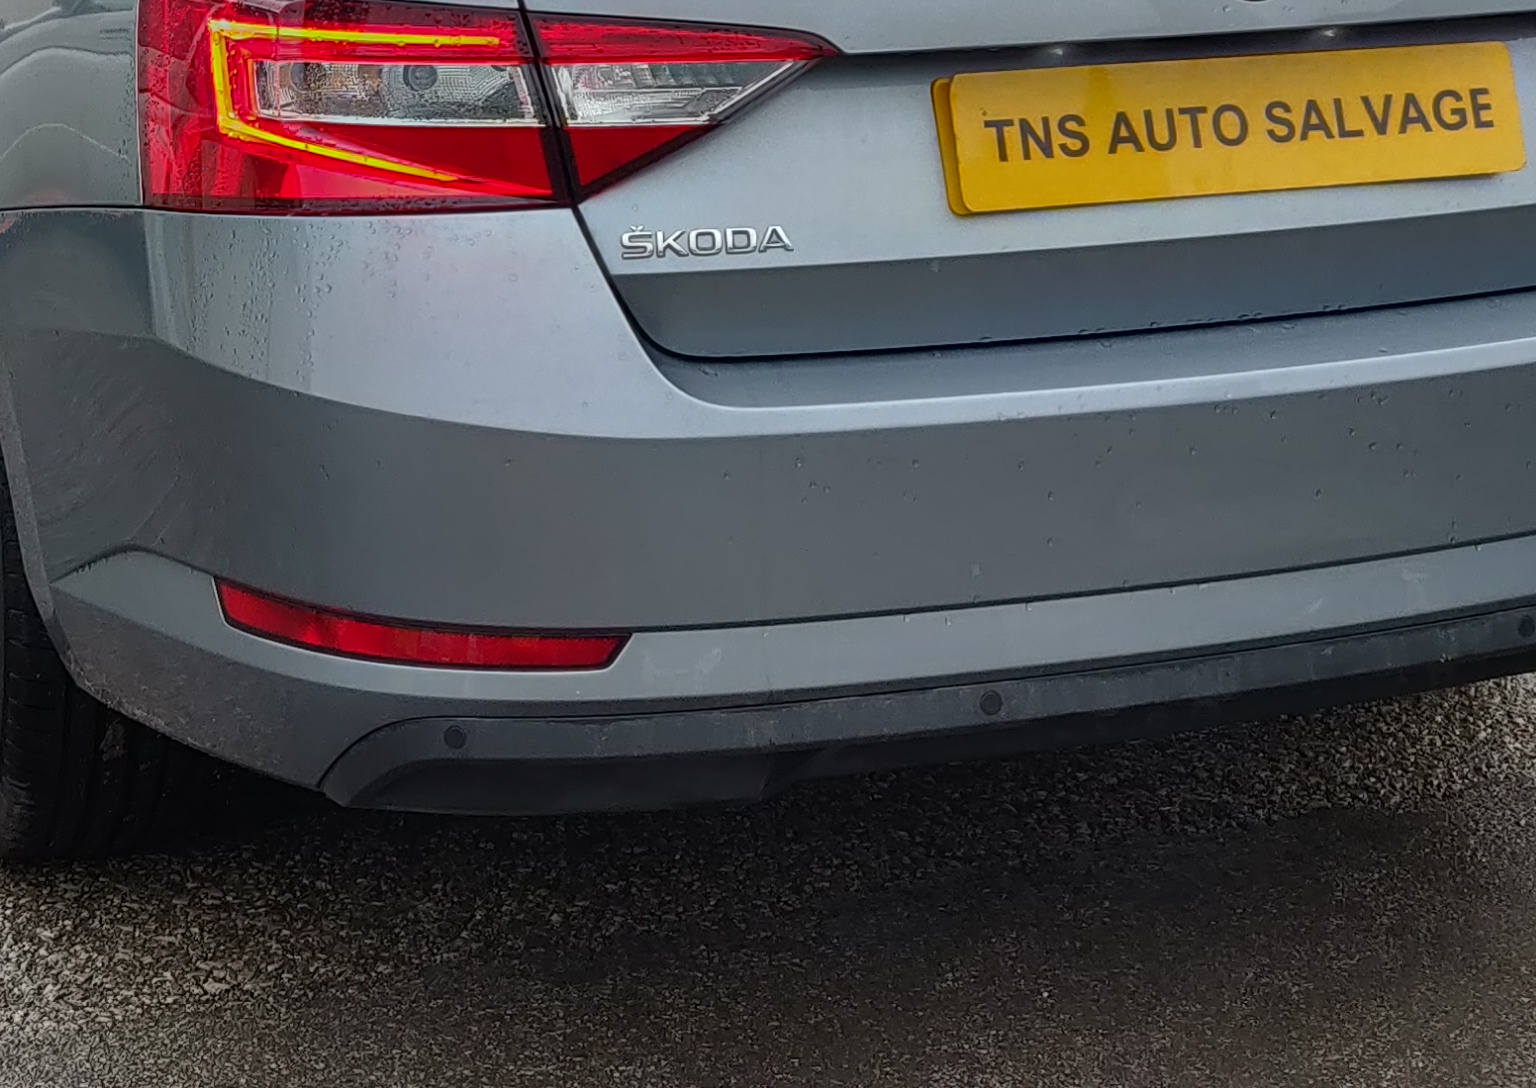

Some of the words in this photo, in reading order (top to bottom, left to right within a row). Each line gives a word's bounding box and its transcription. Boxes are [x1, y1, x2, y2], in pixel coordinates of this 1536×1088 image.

[983, 113, 1091, 164] TNS
[1107, 103, 1249, 155] AUTO
[1265, 87, 1495, 144] SALVAGE
[621, 225, 795, 260] ŠKODA
